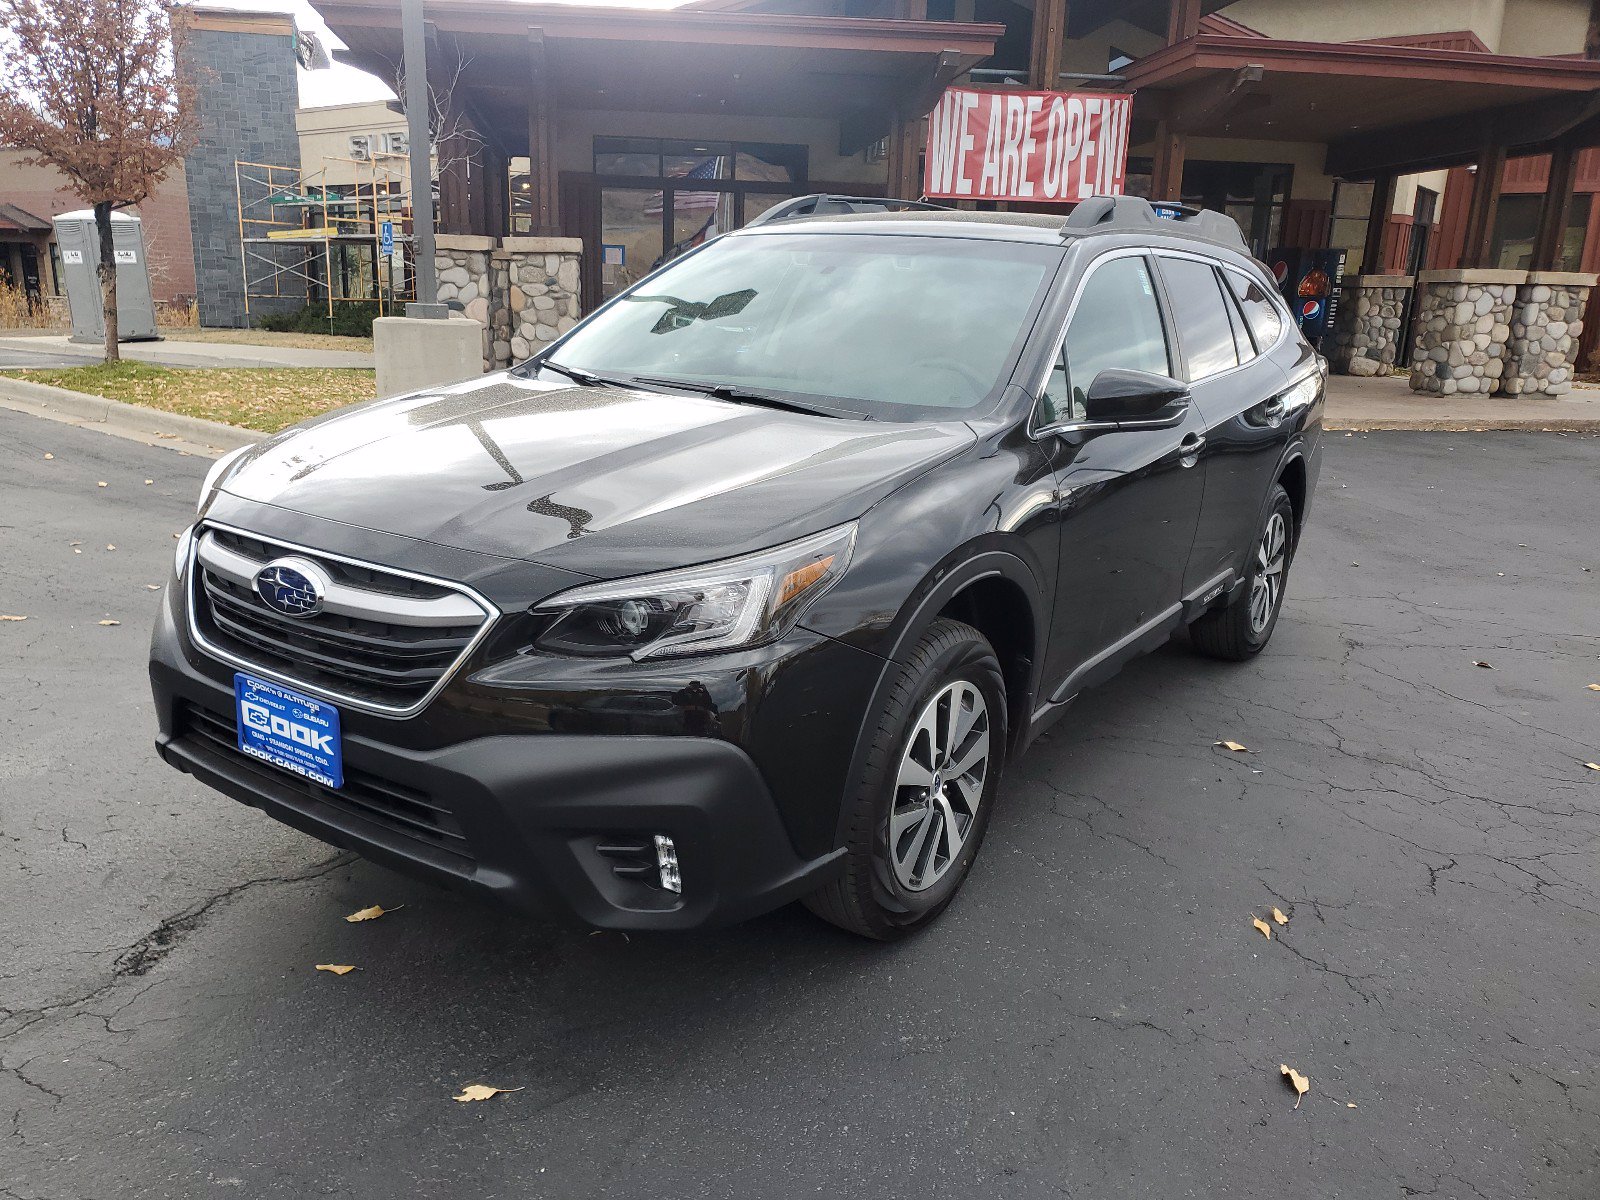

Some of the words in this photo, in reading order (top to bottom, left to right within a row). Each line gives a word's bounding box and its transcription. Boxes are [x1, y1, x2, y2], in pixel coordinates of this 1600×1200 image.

[931, 90, 979, 195] WE
[979, 94, 1044, 197] ARE
[1043, 96, 1129, 199] OPEN!
[240, 700, 335, 756] COOK
[303, 713, 329, 727] SUBARU
[242, 745, 334, 788] COOK-CARS.COM
